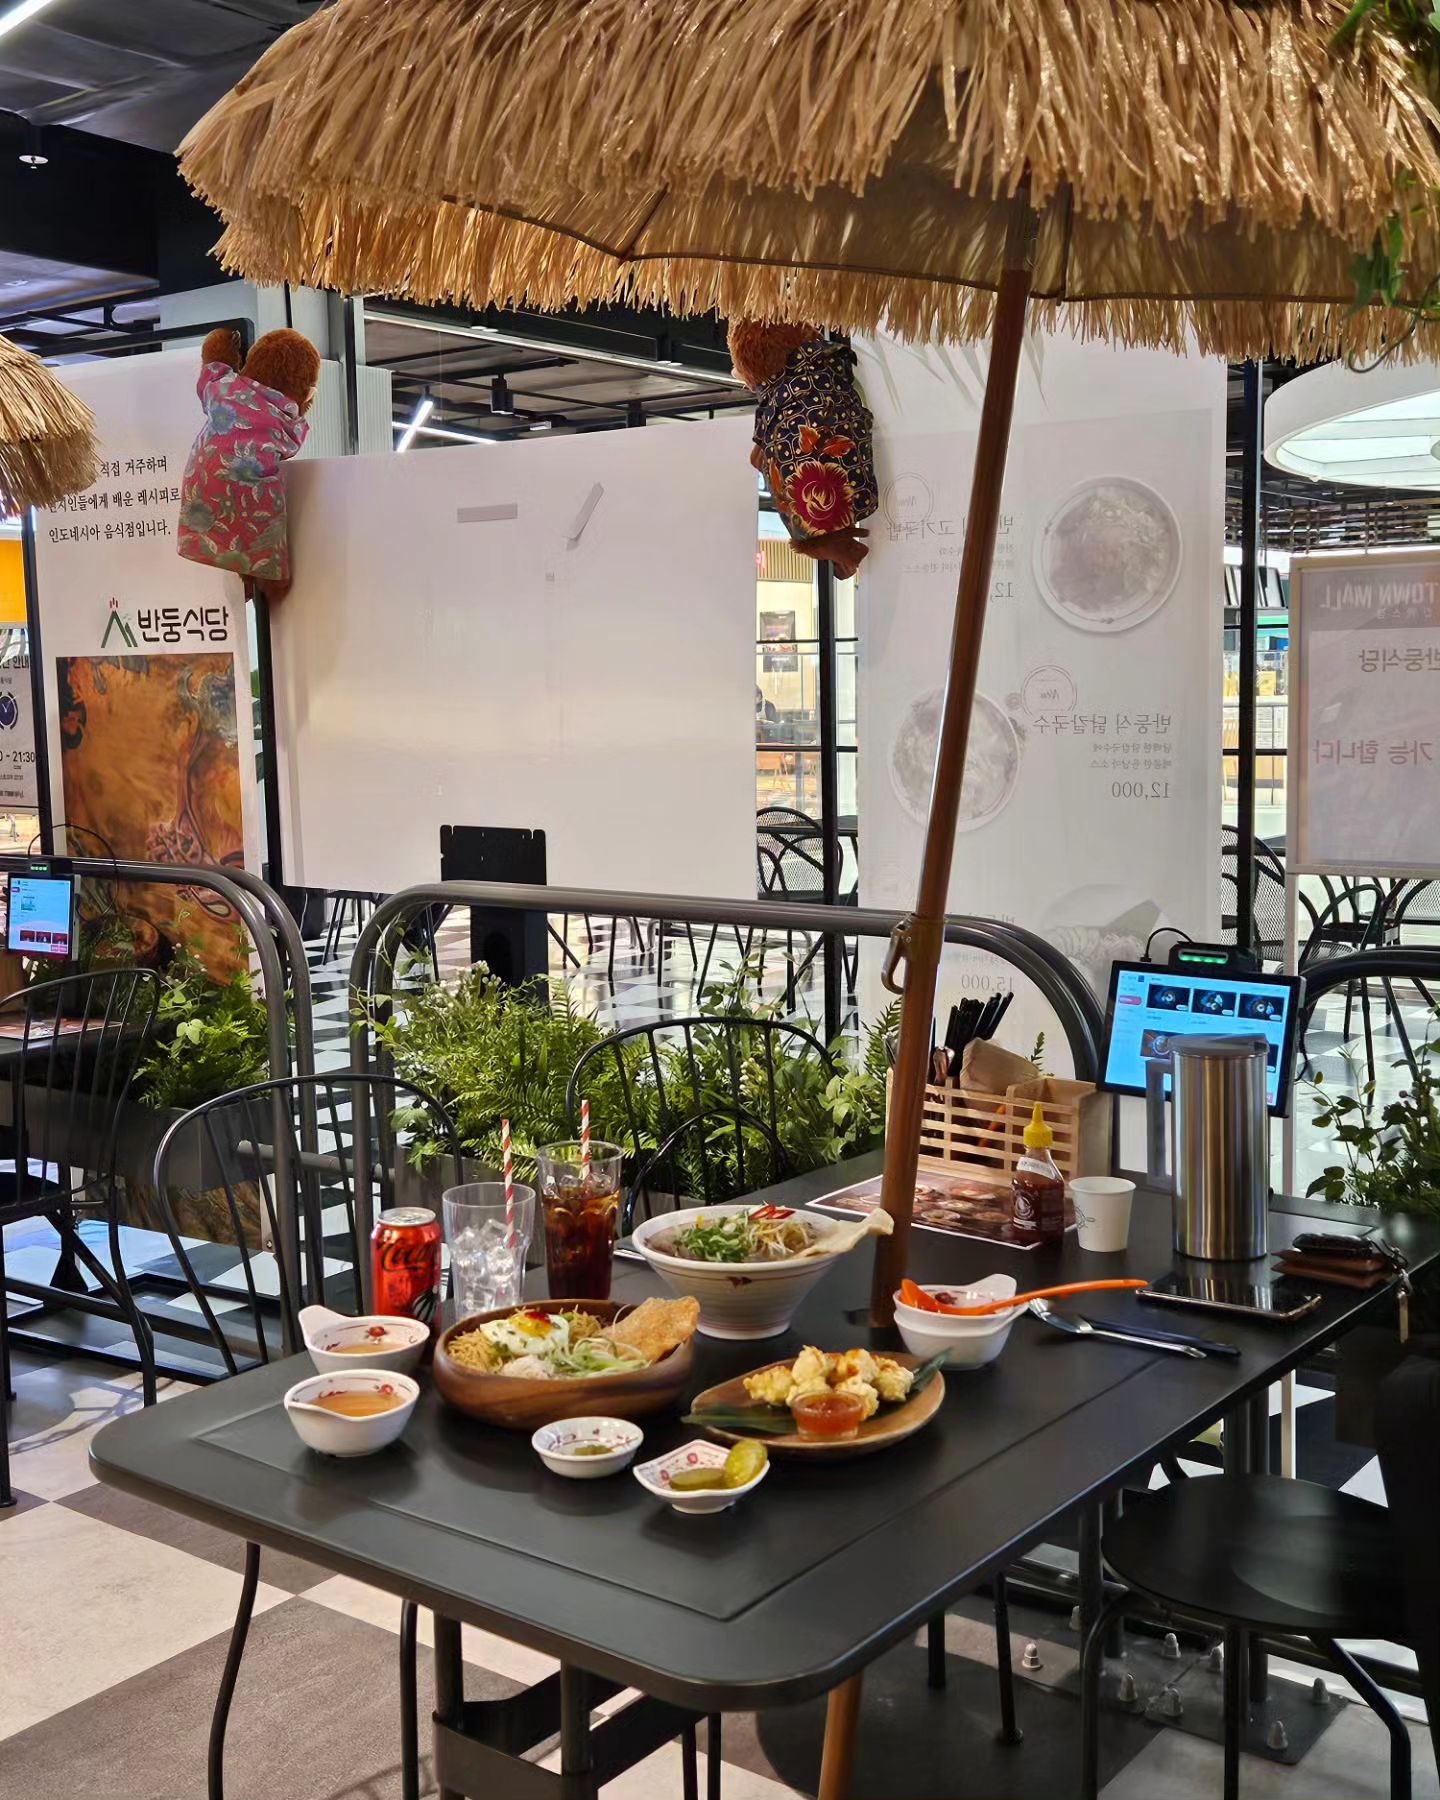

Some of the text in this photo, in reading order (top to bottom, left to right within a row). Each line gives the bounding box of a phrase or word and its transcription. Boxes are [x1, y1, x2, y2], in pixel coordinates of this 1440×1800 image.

[100, 455, 167, 478] 직접 거주하며
[111, 490, 134, 508] 배운
[137, 487, 181, 506] 레시피로
[48, 518, 172, 544] 인도네시아 음식점입니다.
[137, 606, 230, 644] 반둥식당
[12, 750, 35, 763] 21:30
